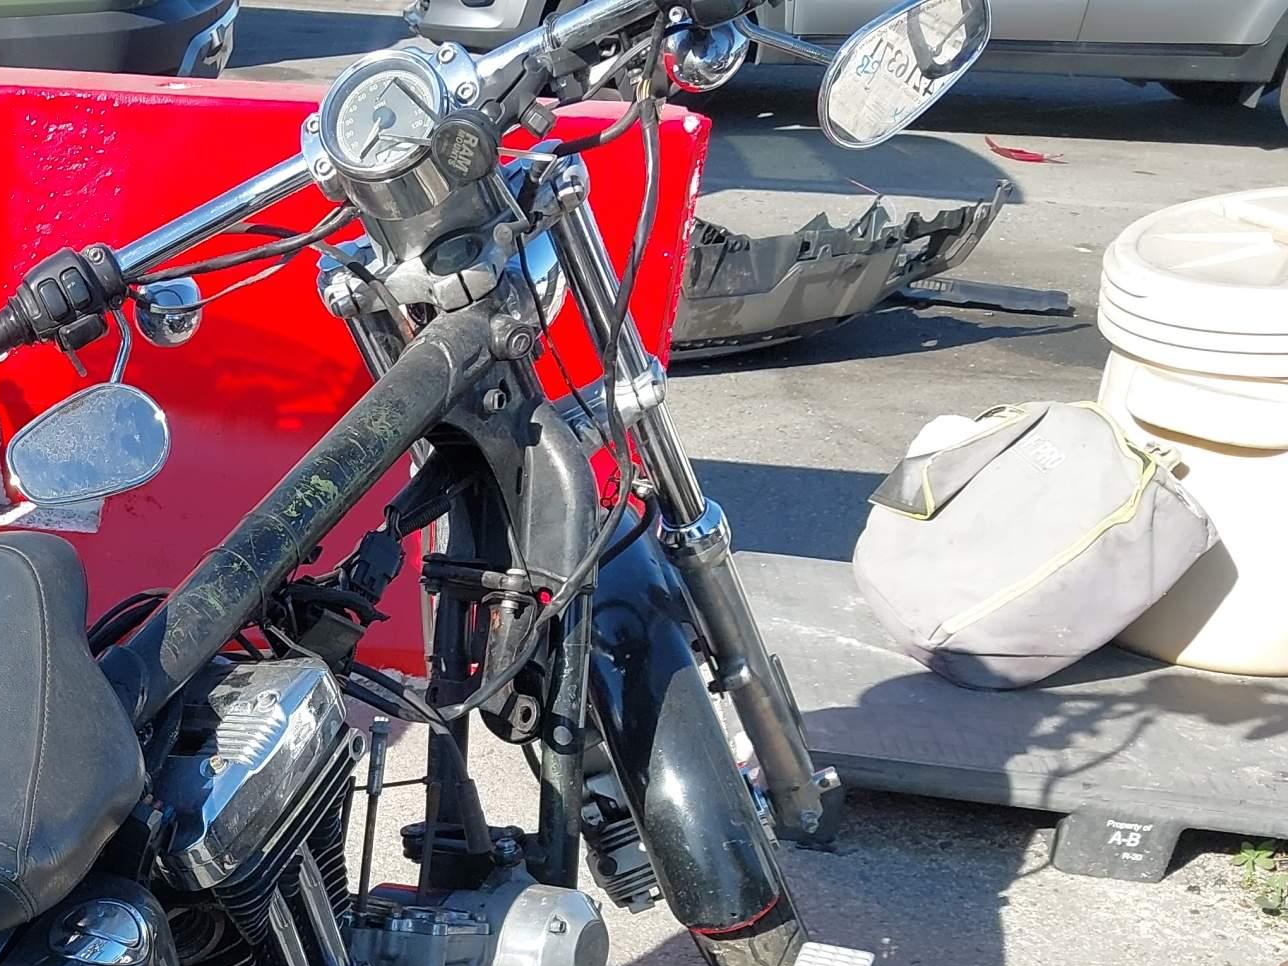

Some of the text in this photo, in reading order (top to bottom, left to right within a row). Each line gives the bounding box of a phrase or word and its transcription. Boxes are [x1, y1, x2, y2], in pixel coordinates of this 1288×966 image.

[448, 128, 465, 167] MOUNTS
[455, 133, 480, 175] RAM
[1106, 819, 1154, 832] Property of
[1107, 831, 1142, 847] A-B
